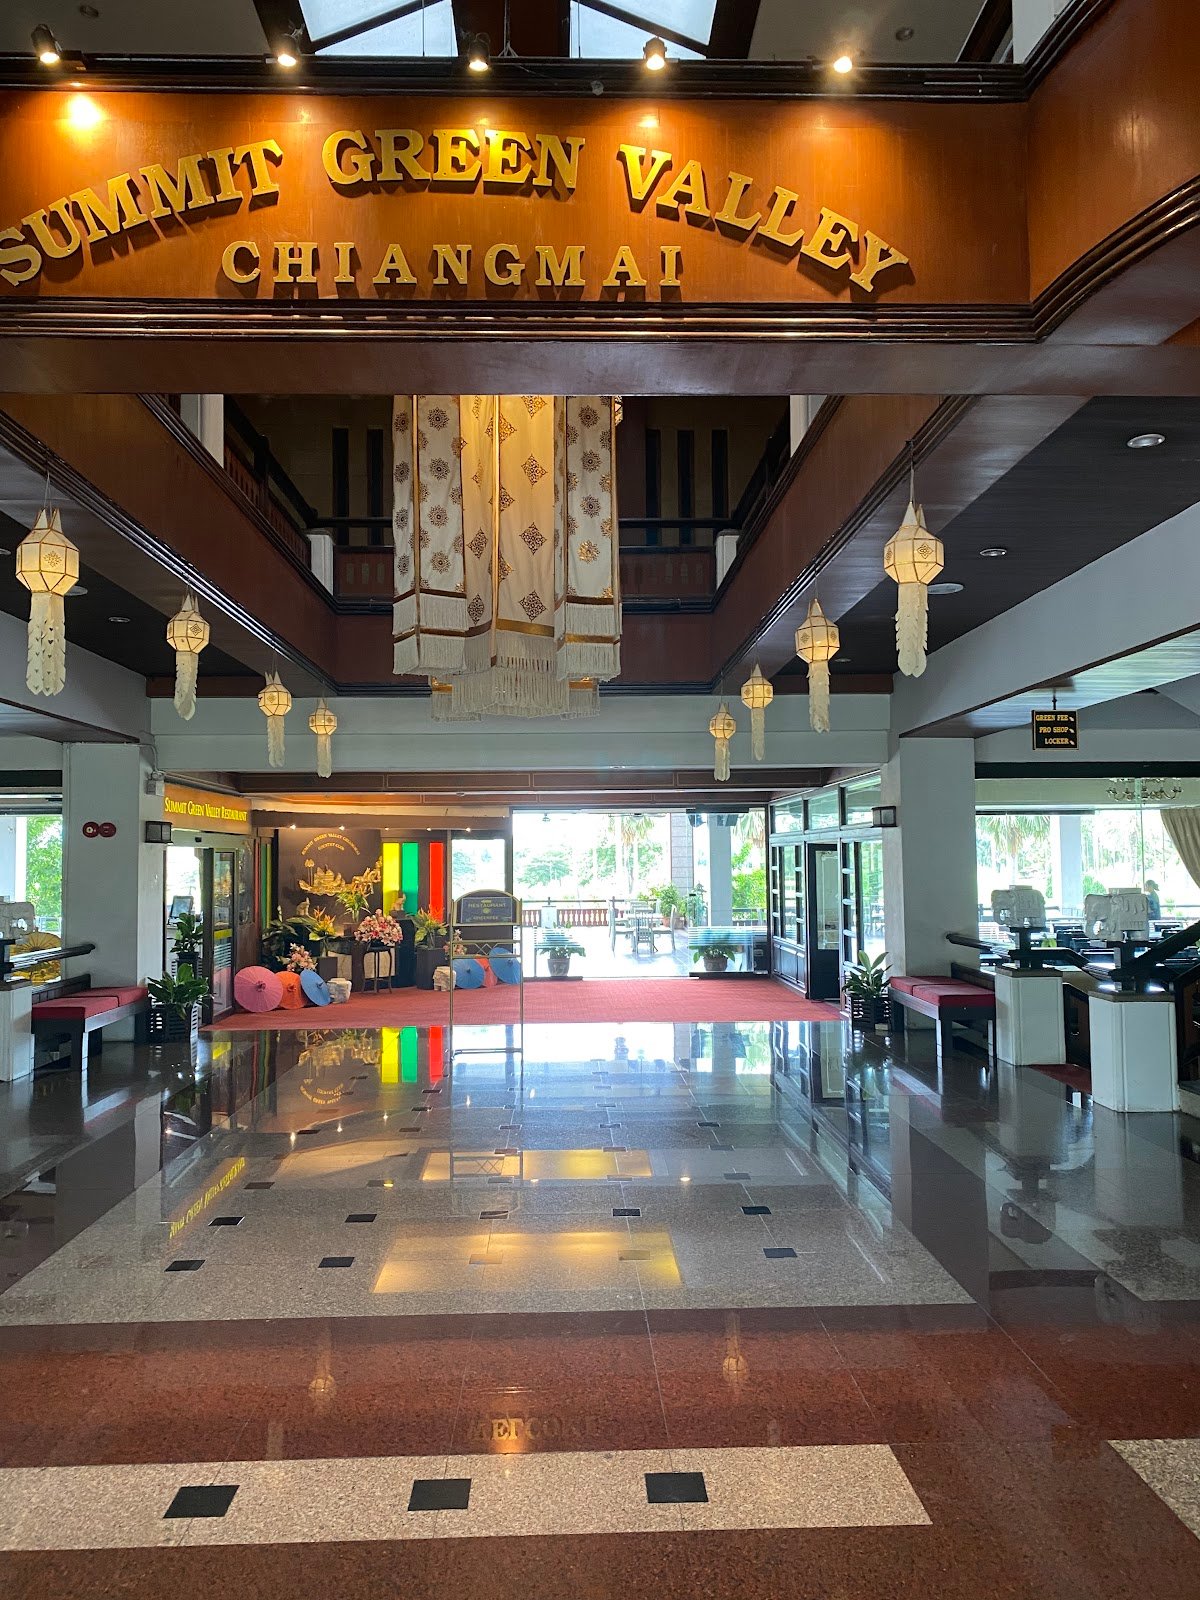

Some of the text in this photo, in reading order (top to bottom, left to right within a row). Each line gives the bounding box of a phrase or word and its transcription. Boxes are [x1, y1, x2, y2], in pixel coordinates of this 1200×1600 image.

[0, 128, 909, 293] SUMMIT GREEN VALLEY
[221, 240, 681, 287] CHIANGMAI
[165, 797, 248, 821] SUMMIT GREEN VALLEY RESTAURANT
